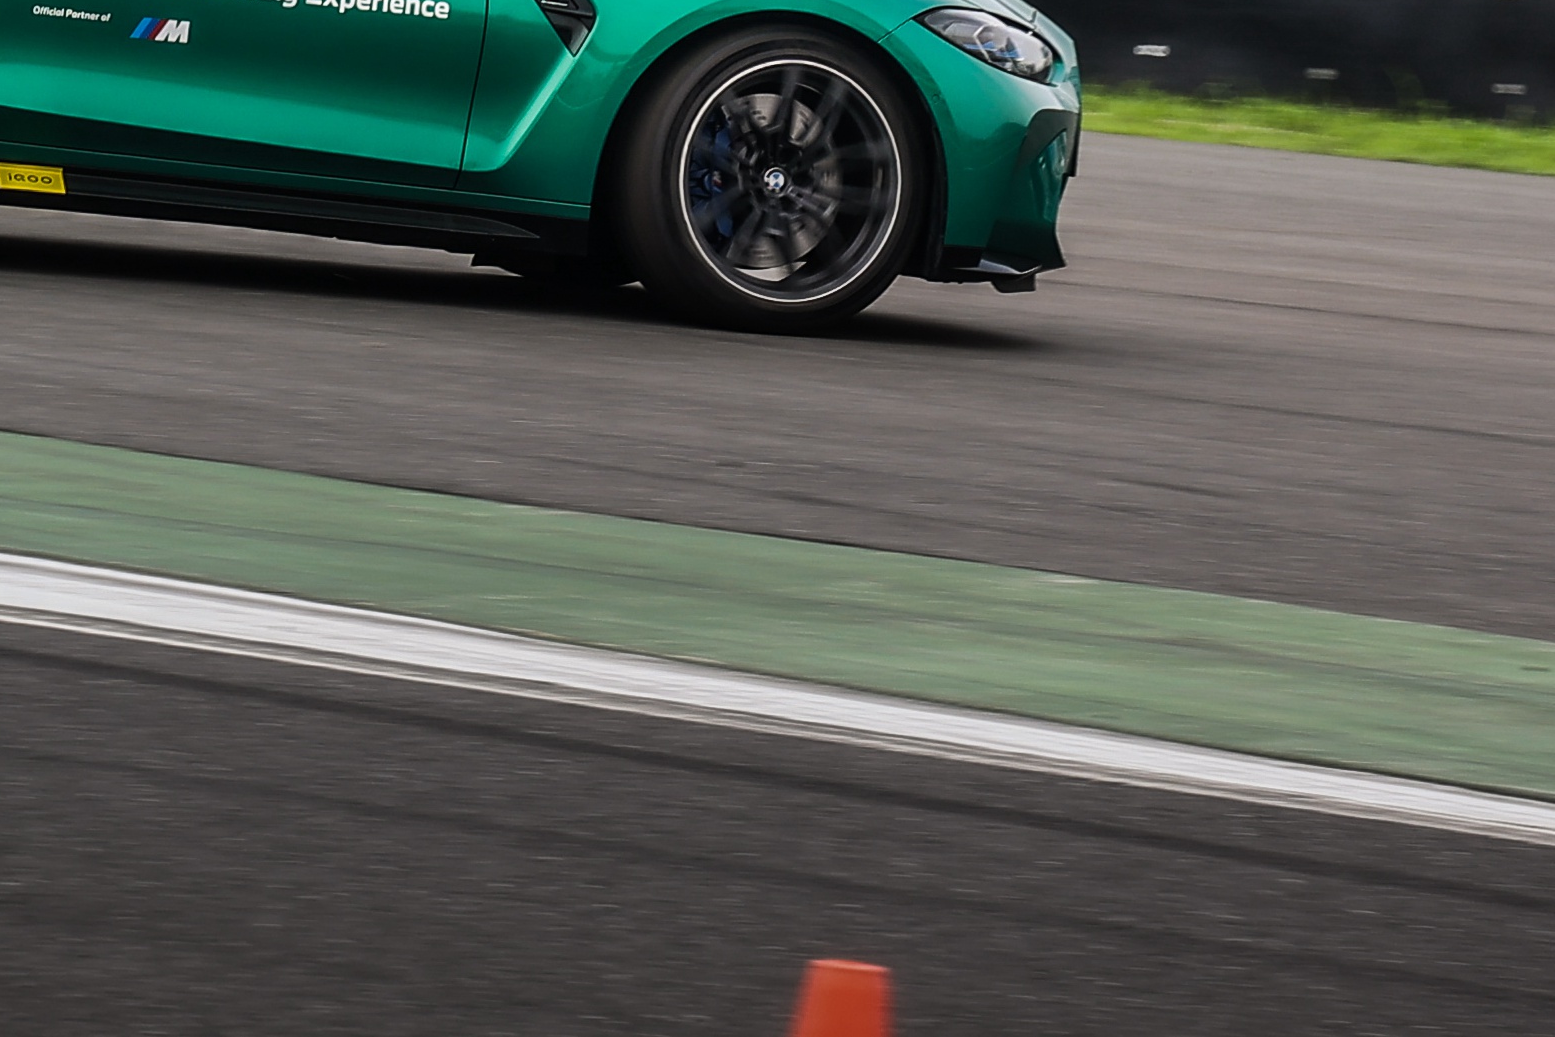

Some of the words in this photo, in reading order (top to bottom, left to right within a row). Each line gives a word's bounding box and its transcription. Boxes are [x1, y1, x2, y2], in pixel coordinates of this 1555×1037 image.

[32, 5, 65, 16] Official
[65, 8, 100, 21] Partner
[100, 13, 111, 22] of
